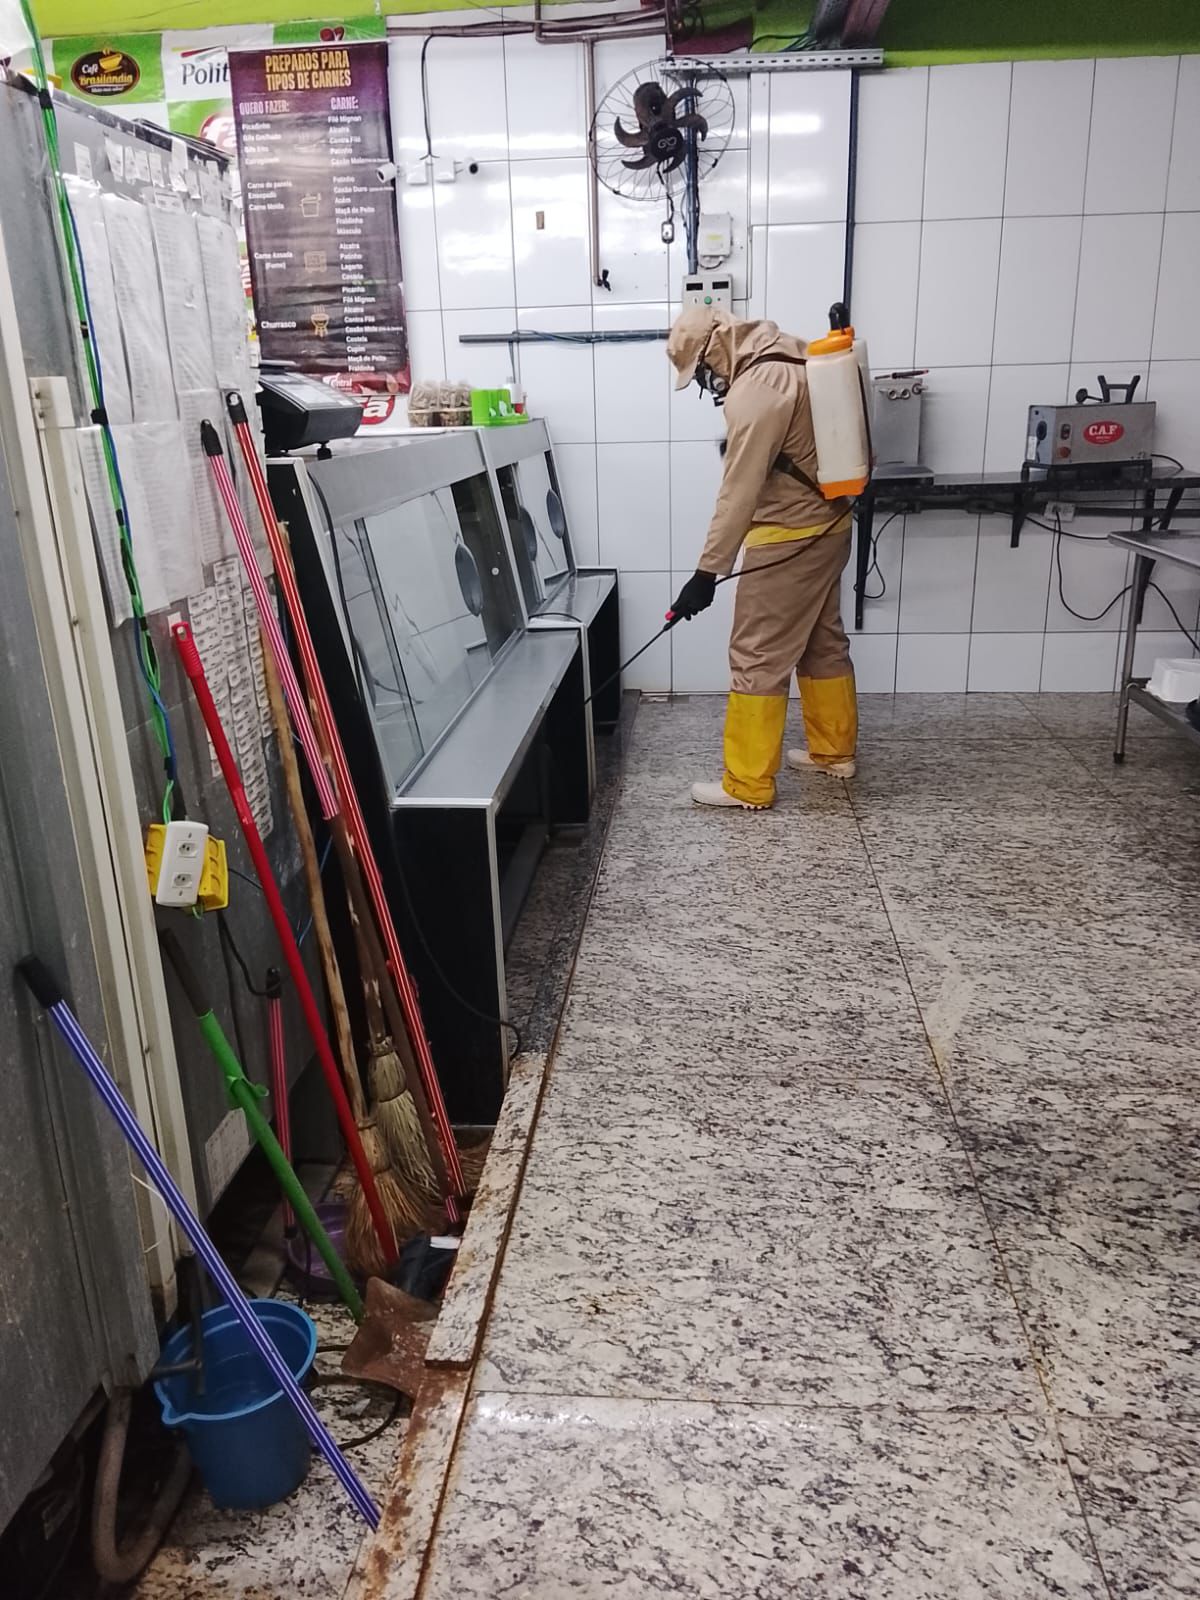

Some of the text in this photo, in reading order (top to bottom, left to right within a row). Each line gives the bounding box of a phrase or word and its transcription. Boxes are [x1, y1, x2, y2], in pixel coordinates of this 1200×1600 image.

[265, 50, 350, 72] PREPAROS PARA
[265, 69, 351, 91] TIPOS DE CARNES
[239, 100, 290, 115] QUERO FAZER:
[330, 95, 359, 110] CARNE:
[261, 320, 297, 329] Churrasco
